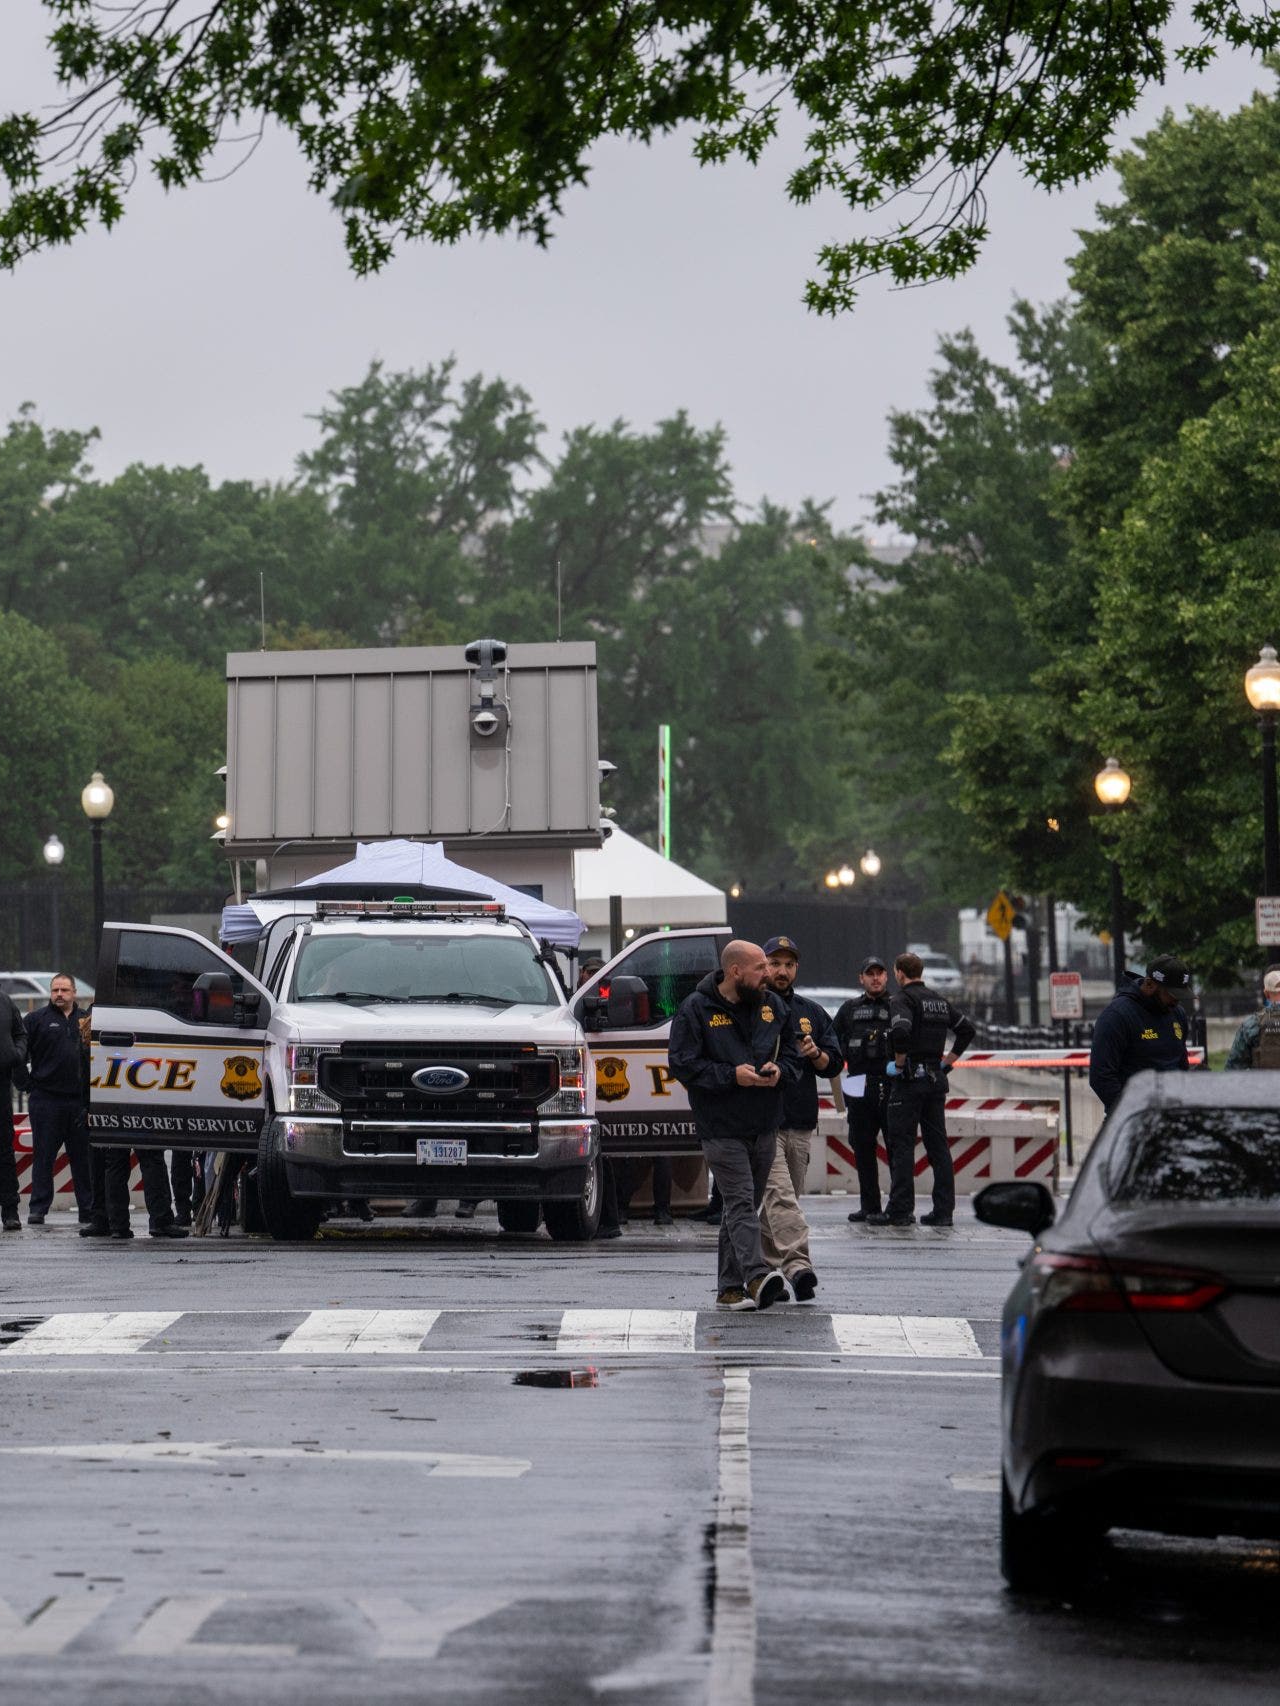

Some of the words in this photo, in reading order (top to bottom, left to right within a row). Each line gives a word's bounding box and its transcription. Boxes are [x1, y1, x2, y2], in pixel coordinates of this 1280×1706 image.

[922, 1000, 949, 1014] POLICE
[426, 1071, 454, 1085] Ford
[123, 1115, 184, 1131] SECRET
[188, 1117, 257, 1133] SERVICE
[600, 1123, 649, 1137] NITED
[652, 1122, 697, 1136] STATE
[433, 1146, 463, 1158] 131287
